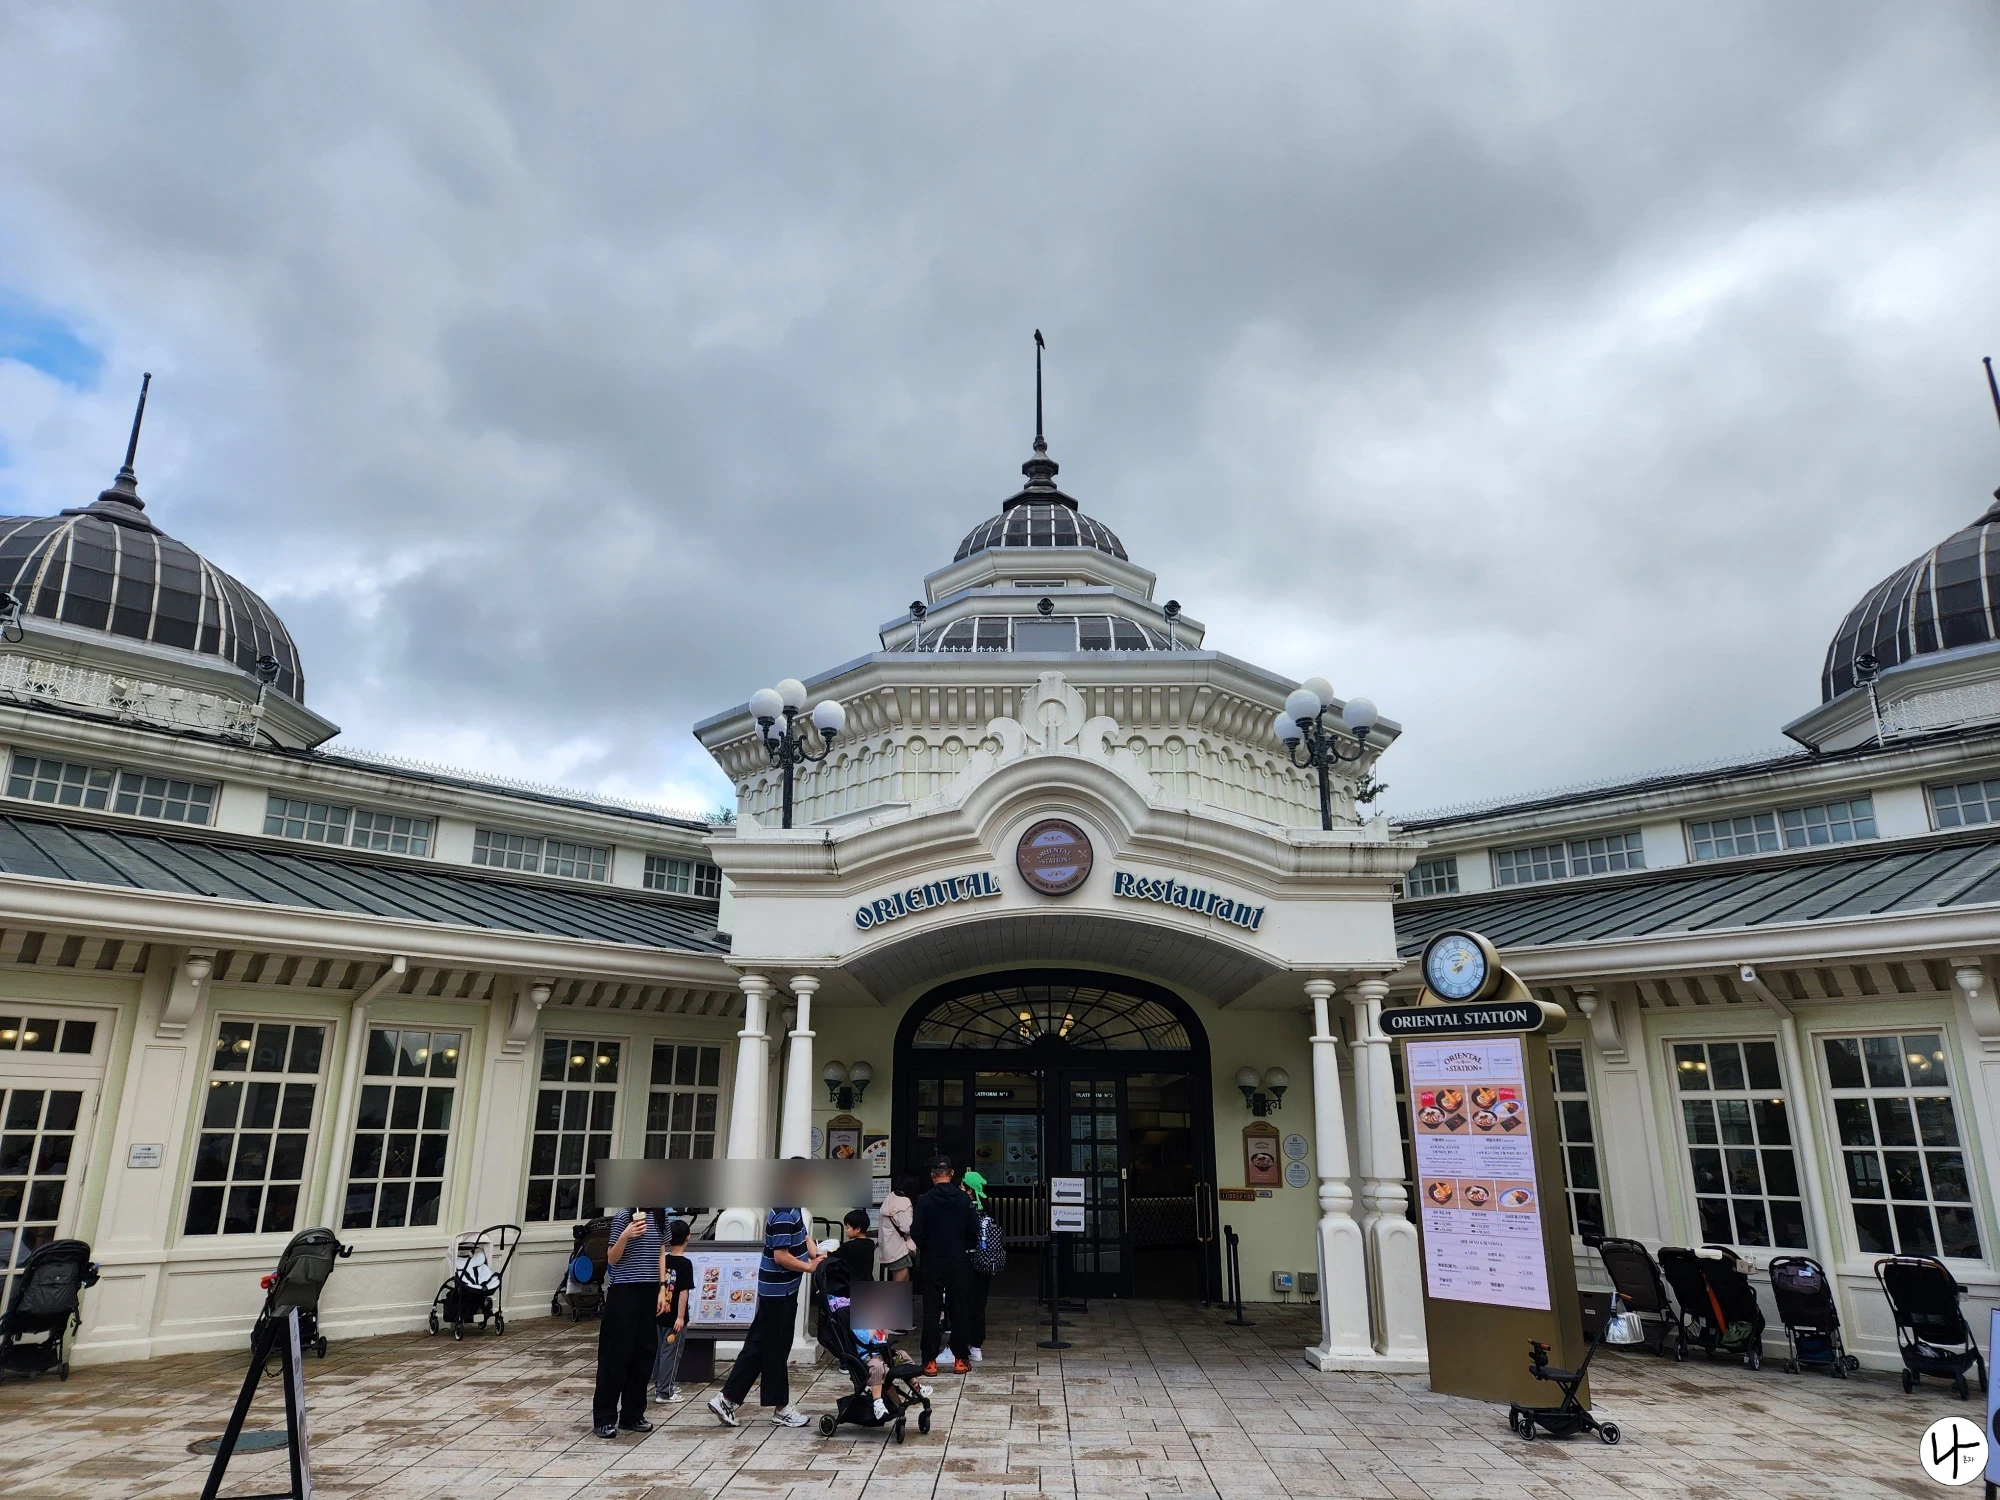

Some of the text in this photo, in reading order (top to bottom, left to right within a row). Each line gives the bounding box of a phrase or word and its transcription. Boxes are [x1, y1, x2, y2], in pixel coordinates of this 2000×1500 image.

[1038, 823, 1060, 832] ORIENTAL
[1061, 823, 1079, 837] STATION
[1036, 847, 1072, 859] ORIENTAL
[1040, 857, 1069, 865] STATION
[1034, 878, 1049, 889] HAVE
[1068, 874, 1079, 885] TRIP
[854, 870, 1267, 932] ORIENTAL Restaurant
[1391, 1009, 1528, 1029] ORIENTAL STATION
[1443, 1052, 1482, 1065] ORIENTAL
